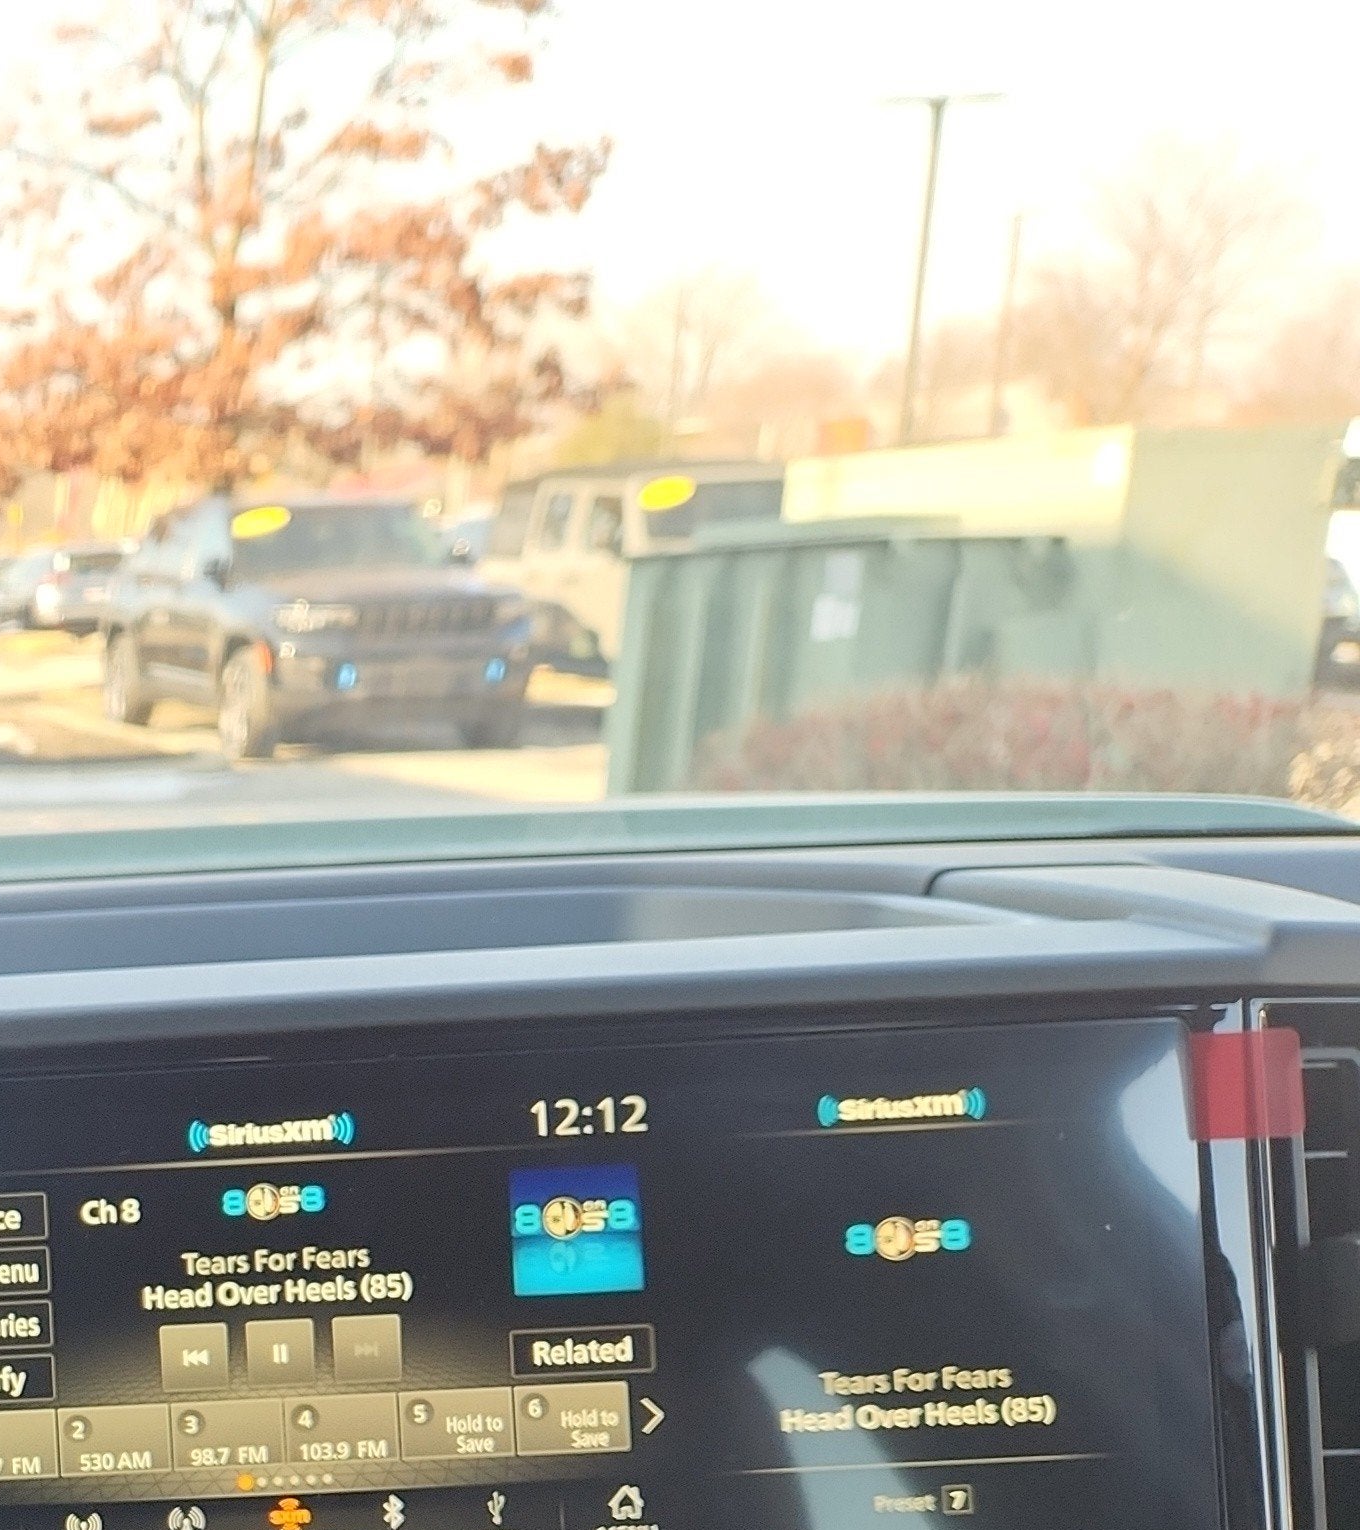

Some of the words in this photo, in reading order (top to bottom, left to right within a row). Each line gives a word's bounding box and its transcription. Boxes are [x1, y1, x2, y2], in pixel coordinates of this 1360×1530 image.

[530, 1094, 649, 1137] 12:12
[80, 1198, 118, 1225] Ch
[121, 1197, 141, 1223] 8
[182, 1252, 251, 1276] Tears
[253, 1249, 297, 1272] For
[301, 1246, 371, 1270] Fears
[143, 1282, 214, 1310] Head
[216, 1281, 281, 1307] Over
[283, 1275, 358, 1303] Heels
[360, 1271, 414, 1303] (85)
[532, 1336, 634, 1366] Related
[818, 1371, 892, 1396] Tears
[892, 1368, 939, 1392] For
[941, 1366, 1015, 1391] Fears
[413, 1404, 427, 1424] 5
[528, 1398, 543, 1418] 6
[560, 1409, 600, 1428] Hold
[601, 1412, 619, 1427] to
[780, 1404, 855, 1433] Head
[855, 1404, 924, 1430] Over
[924, 1398, 1000, 1427] Heels
[1000, 1394, 1058, 1427] (85)
[71, 1420, 85, 1440] 2
[184, 1415, 199, 1435] 3
[298, 1409, 314, 1430] 4
[446, 1413, 483, 1434] Hold
[485, 1416, 504, 1431] to
[456, 1435, 495, 1453] Save
[571, 1430, 611, 1448] Save
[191, 1447, 231, 1466] 98.7
[237, 1445, 269, 1464] FM
[299, 1442, 351, 1461] 103.9
[357, 1440, 389, 1459] FM
[11, 1456, 42, 1475] FM
[79, 1453, 116, 1472] 530
[117, 1451, 153, 1471] AM
